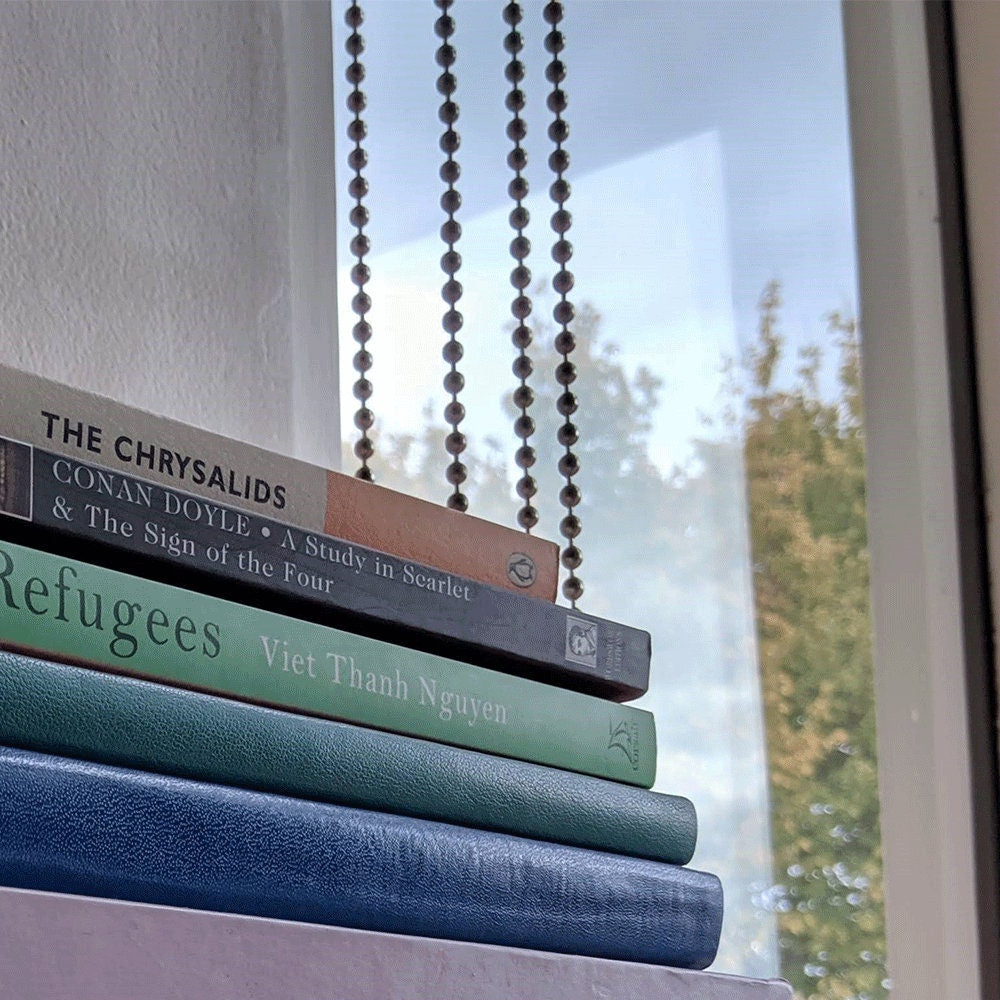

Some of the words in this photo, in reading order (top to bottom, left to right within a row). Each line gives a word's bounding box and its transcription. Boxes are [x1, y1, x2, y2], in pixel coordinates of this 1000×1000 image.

[41, 410, 102, 454] THE
[114, 435, 288, 510] CHRYSALIDS
[52, 459, 154, 508] CONAN
[163, 490, 251, 538] DOYLE
[280, 529, 297, 551] A
[305, 533, 368, 575] Study
[374, 556, 395, 580] in
[402, 563, 472, 602] Scarlet
[52, 496, 75, 522] &
[85, 503, 134, 539] The
[144, 522, 197, 558] Sign
[206, 542, 232, 566] of
[238, 550, 275, 578] the
[283, 561, 335, 595] Four
[259, 635, 316, 678] Viet
[325, 651, 409, 709] Thanh
[418, 675, 508, 726] Nguyen
